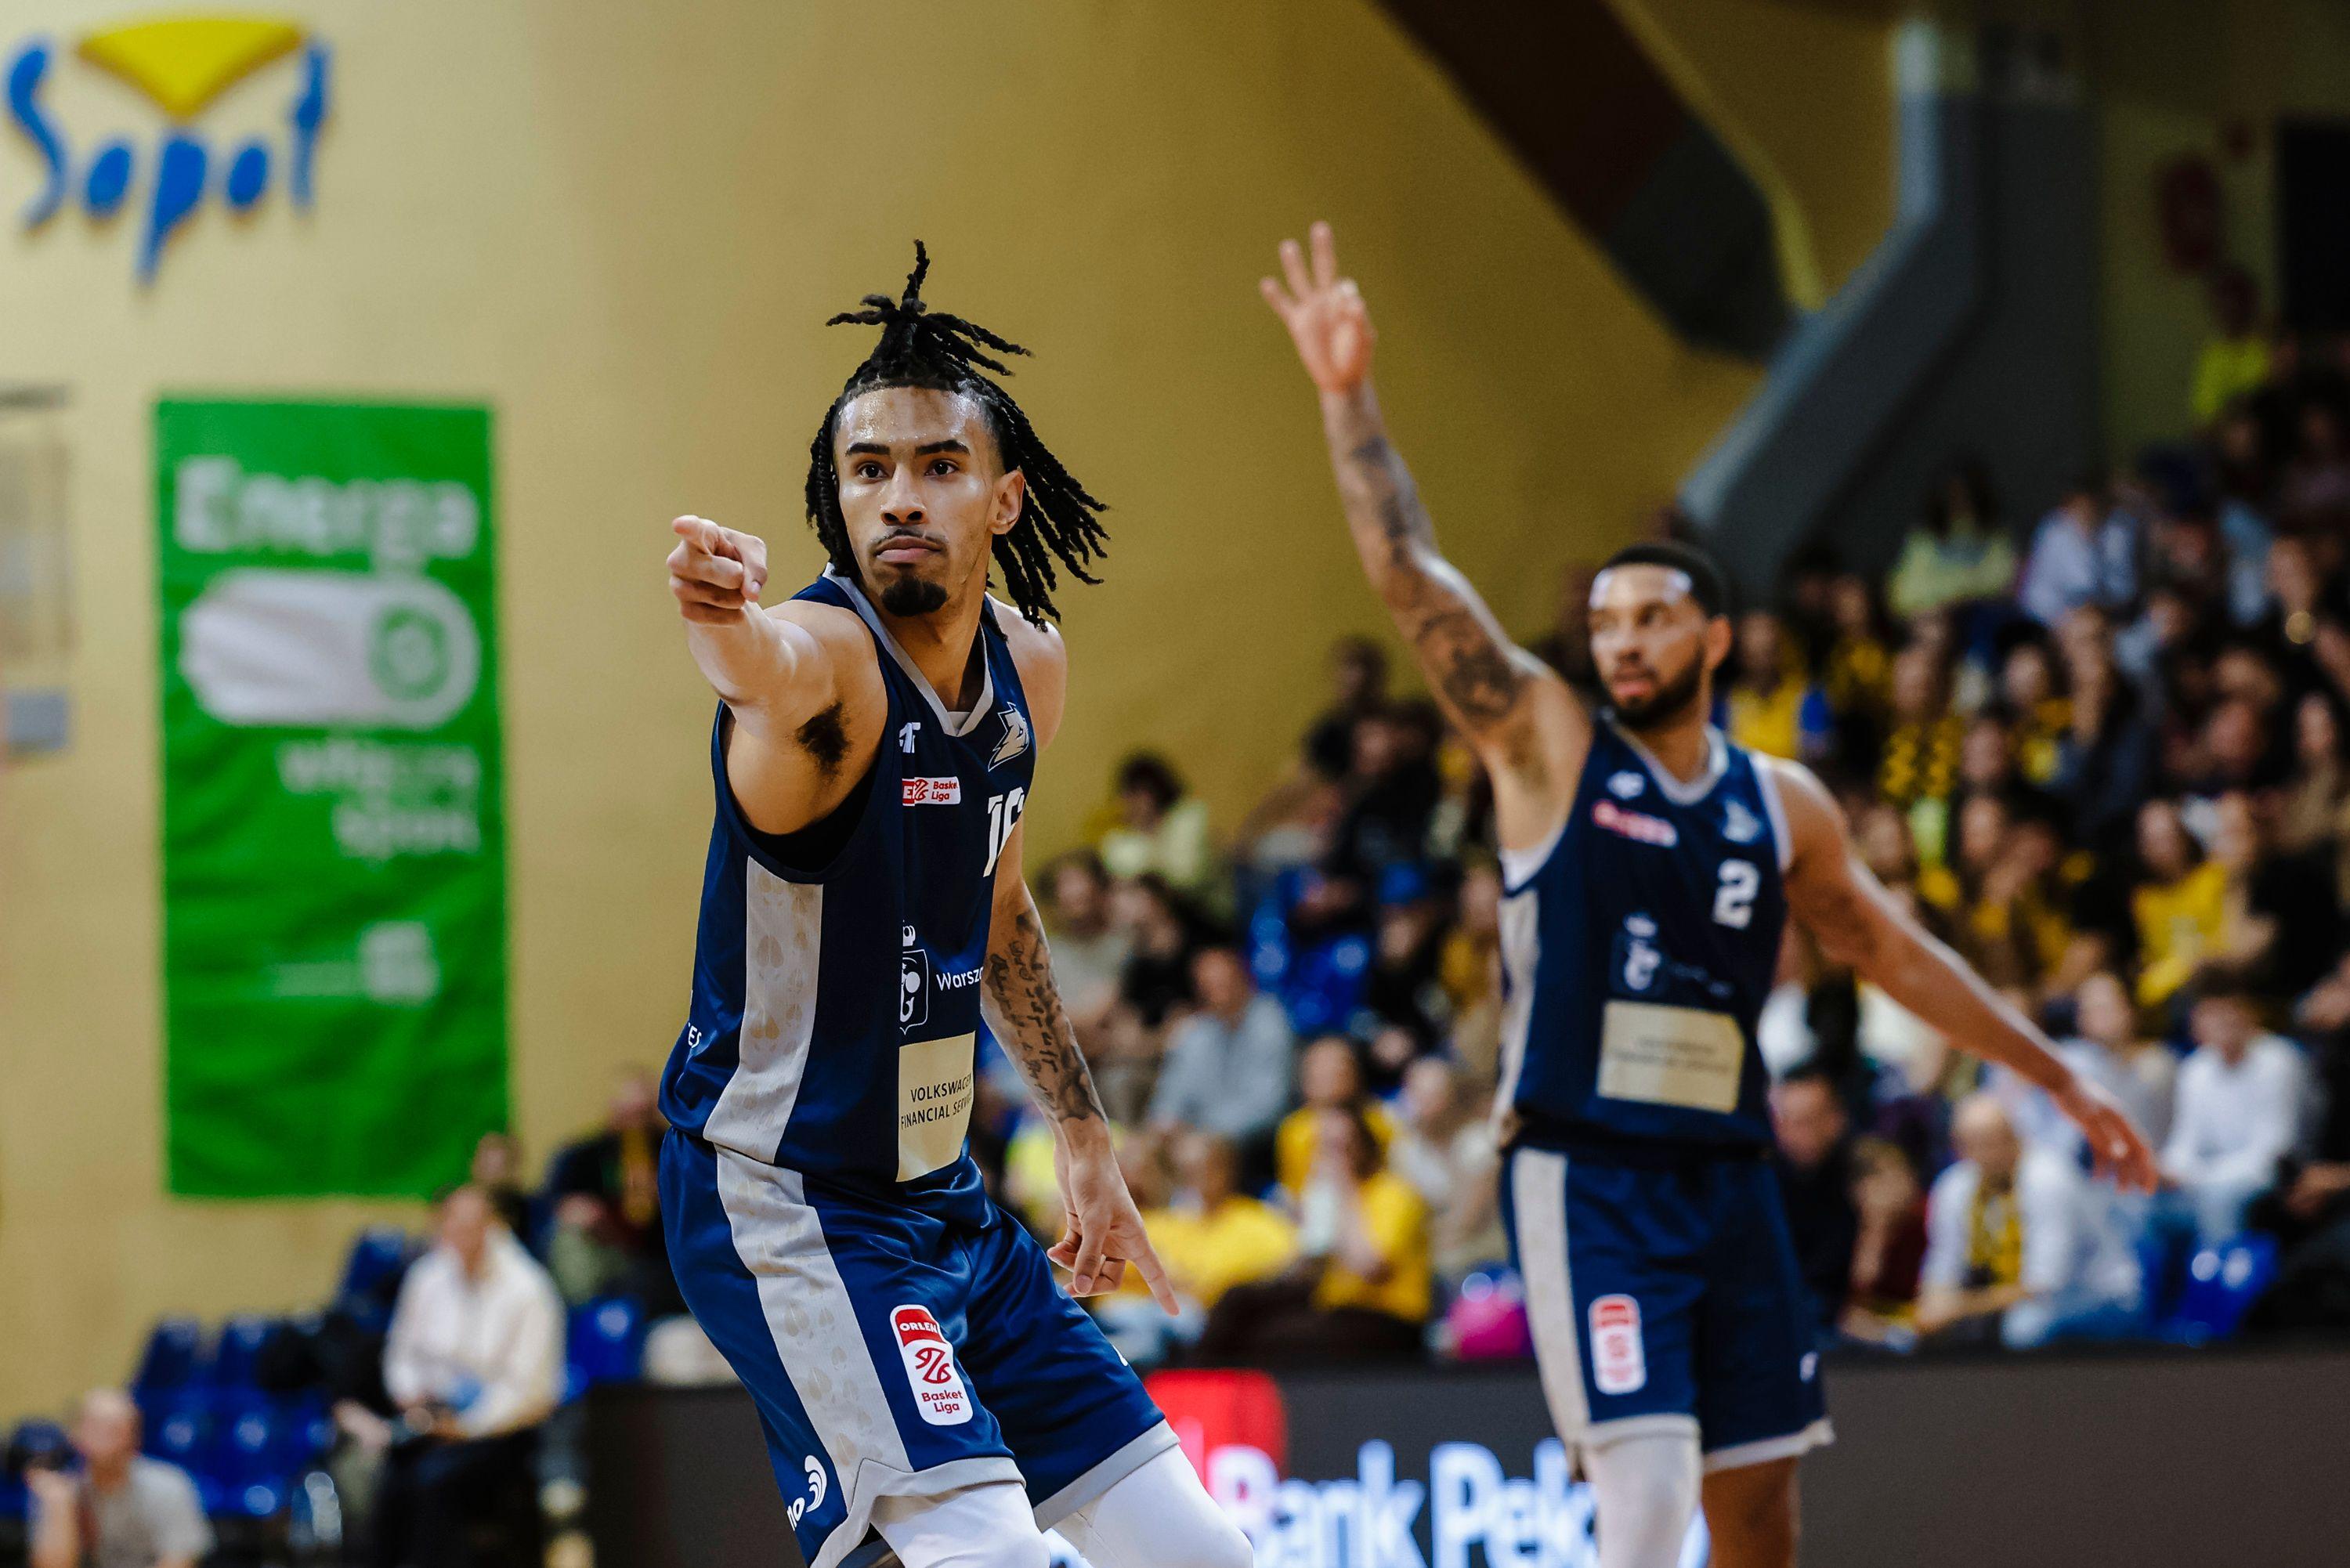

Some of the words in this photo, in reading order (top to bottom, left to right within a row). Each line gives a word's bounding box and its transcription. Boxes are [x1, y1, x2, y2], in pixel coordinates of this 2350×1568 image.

[933, 780, 958, 790] Baske
[931, 791, 949, 802] Liga
[1712, 858, 1761, 930] 2
[901, 1104, 949, 1129] FINANCIAL
[899, 1321, 938, 1333] ORLEN
[921, 1389, 964, 1402] Basket
[934, 1402, 960, 1414] Liga
